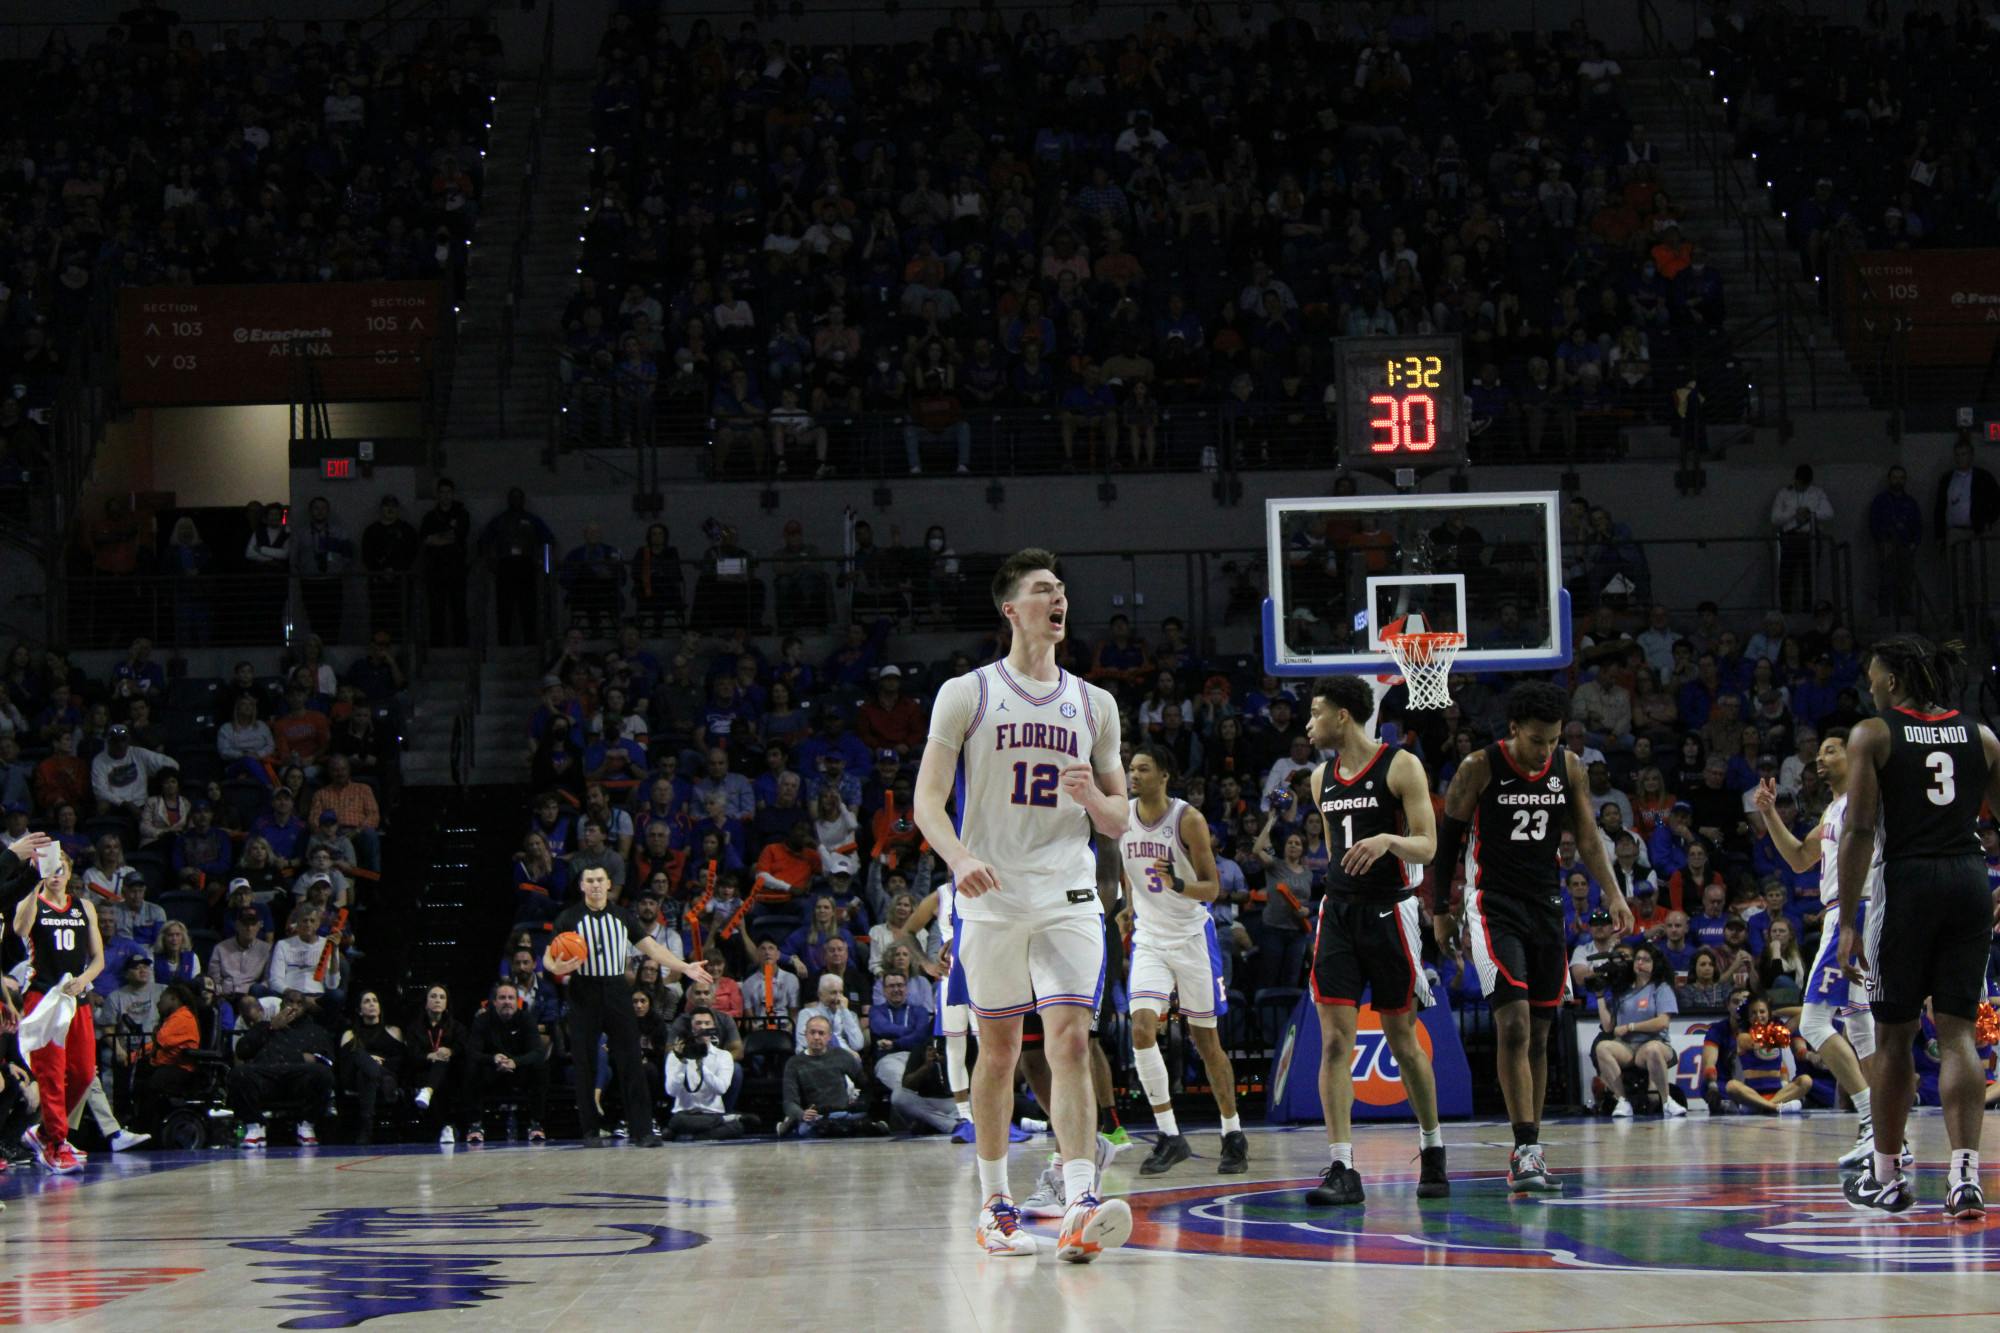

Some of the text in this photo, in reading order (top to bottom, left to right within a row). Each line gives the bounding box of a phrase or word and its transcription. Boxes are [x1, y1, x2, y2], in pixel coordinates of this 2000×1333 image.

[1887, 283, 1919, 300] 105
[143, 303, 199, 313] SECTION
[370, 297, 426, 308] SECTION
[171, 321, 203, 337] 103
[365, 316, 398, 332] 105
[249, 327, 333, 342] Exactech
[172, 354, 198, 371] 03
[1388, 356, 1442, 388] 1:32
[1370, 394, 1436, 452] 30
[326, 459, 349, 478] EXIT
[996, 722, 1079, 758] FLORIDA
[1904, 725, 1968, 744] OQUENDO
[1010, 761, 1060, 808] 12
[1925, 751, 1956, 806] 3
[1321, 796, 1379, 813] GEORGIA
[1497, 793, 1567, 805] GEORGIA
[1341, 814, 1354, 849] 1
[1510, 809, 1549, 841] 23
[1127, 841, 1176, 863] FLORIDA
[40, 918, 86, 928] GEORGIA
[53, 928, 76, 951] 10
[1817, 966, 1843, 994] F
